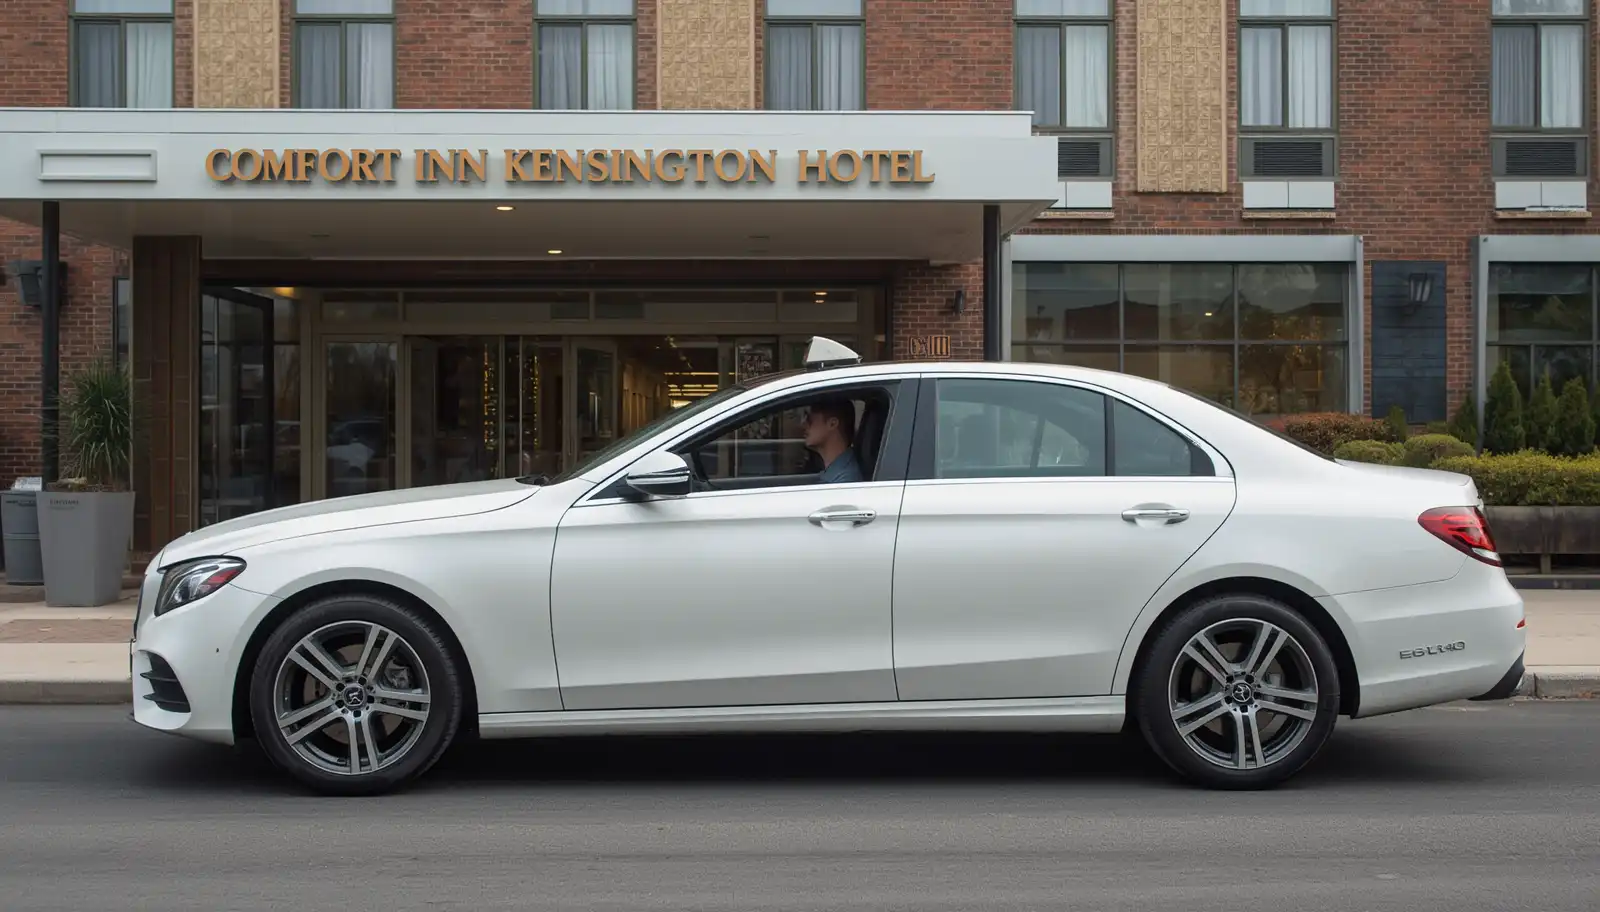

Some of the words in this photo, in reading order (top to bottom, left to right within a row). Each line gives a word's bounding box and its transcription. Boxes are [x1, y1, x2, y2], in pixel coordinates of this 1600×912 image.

[205, 148, 401, 183] COMFORT
[415, 148, 488, 183] INN
[504, 149, 777, 184] KENSINGTON
[798, 149, 935, 184] HOTEL
